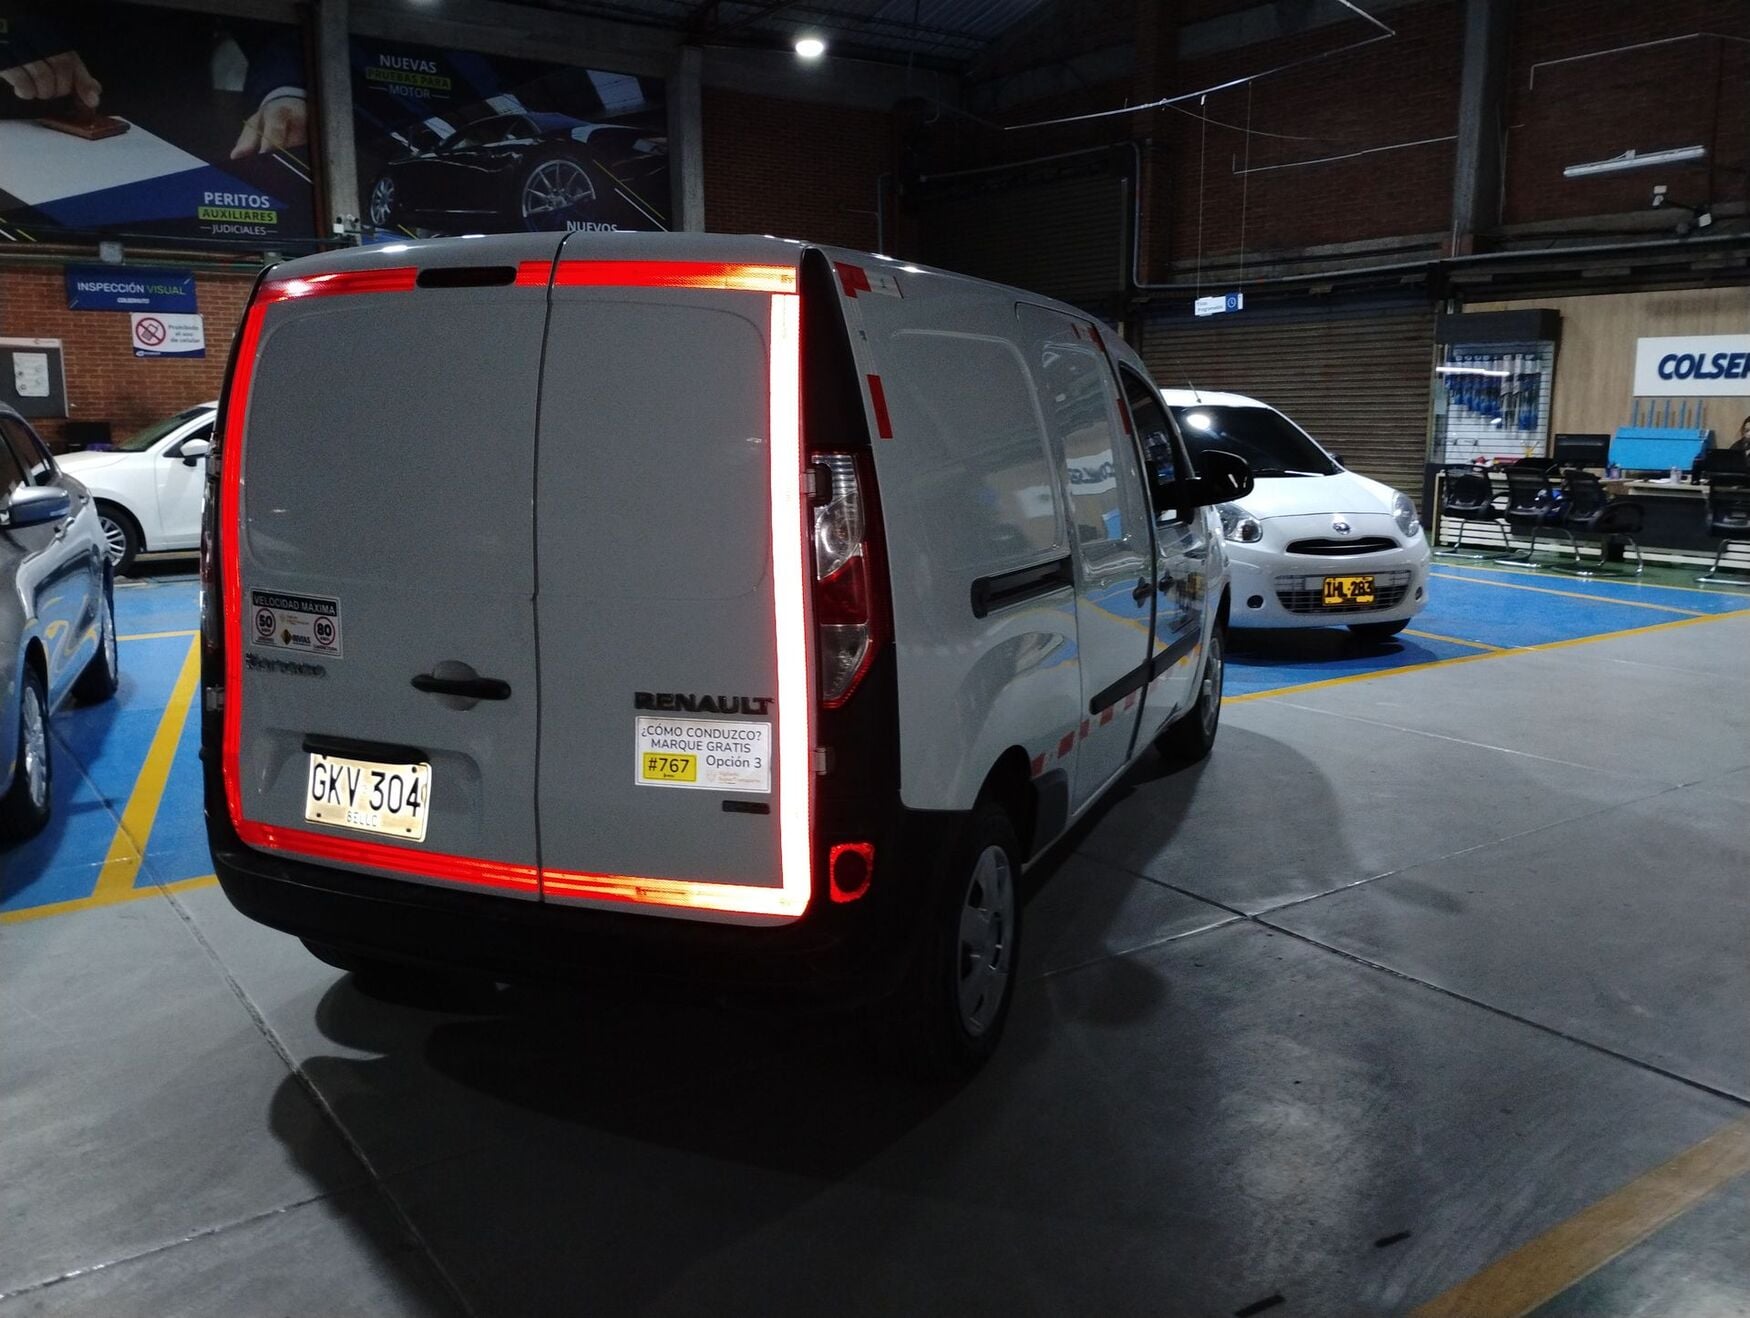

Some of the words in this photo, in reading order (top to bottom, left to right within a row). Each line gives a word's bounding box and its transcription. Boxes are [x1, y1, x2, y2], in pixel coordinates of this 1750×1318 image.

[379, 54, 437, 73] NUEVAS
[367, 68, 419, 83] PRUEBAS
[421, 75, 450, 88] PARA
[388, 85, 432, 99] MOTOR
[203, 191, 271, 208] PERITOS
[202, 208, 274, 222] AUXILIARES
[211, 224, 267, 236] JUDICIALES
[566, 220, 618, 232] NUEVOS
[77, 281, 145, 294] INSPECCIÓN
[146, 284, 187, 295] VISUAL
[253, 595, 300, 610] VELOCIDAD
[258, 614, 273, 628] 50
[317, 622, 332, 637] 80
[634, 691, 775, 715] RENAULT
[641, 723, 683, 738] ¿CÓMO
[686, 727, 762, 741] CONDUZCO?
[650, 738, 703, 753] MARQUE
[706, 741, 752, 753] GRATIS
[648, 757, 690, 774] #767
[705, 754, 750, 769] Opción
[753, 757, 762, 769] 3
[312, 762, 360, 808] GKV
[369, 770, 421, 818] 304
